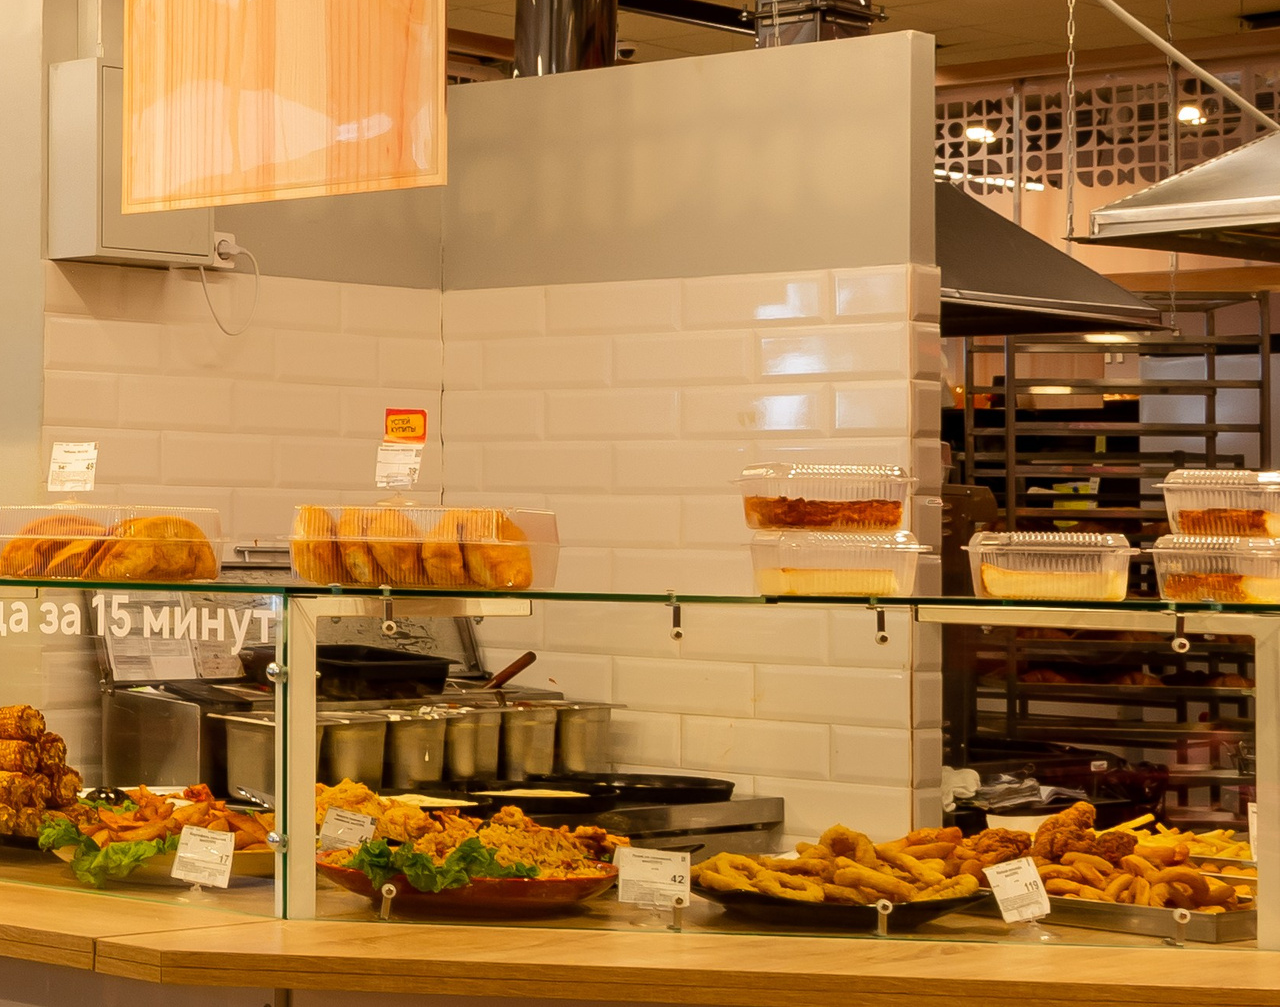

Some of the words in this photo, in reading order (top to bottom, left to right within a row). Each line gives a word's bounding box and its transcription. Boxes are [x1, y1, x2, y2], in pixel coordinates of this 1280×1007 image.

[391, 417, 410, 425] УСПЕЙ
[39, 601, 82, 636] за
[91, 593, 132, 638] 15
[142, 605, 276, 656] минут
[670, 875, 685, 884] 42
[1024, 880, 1040, 892] 119
